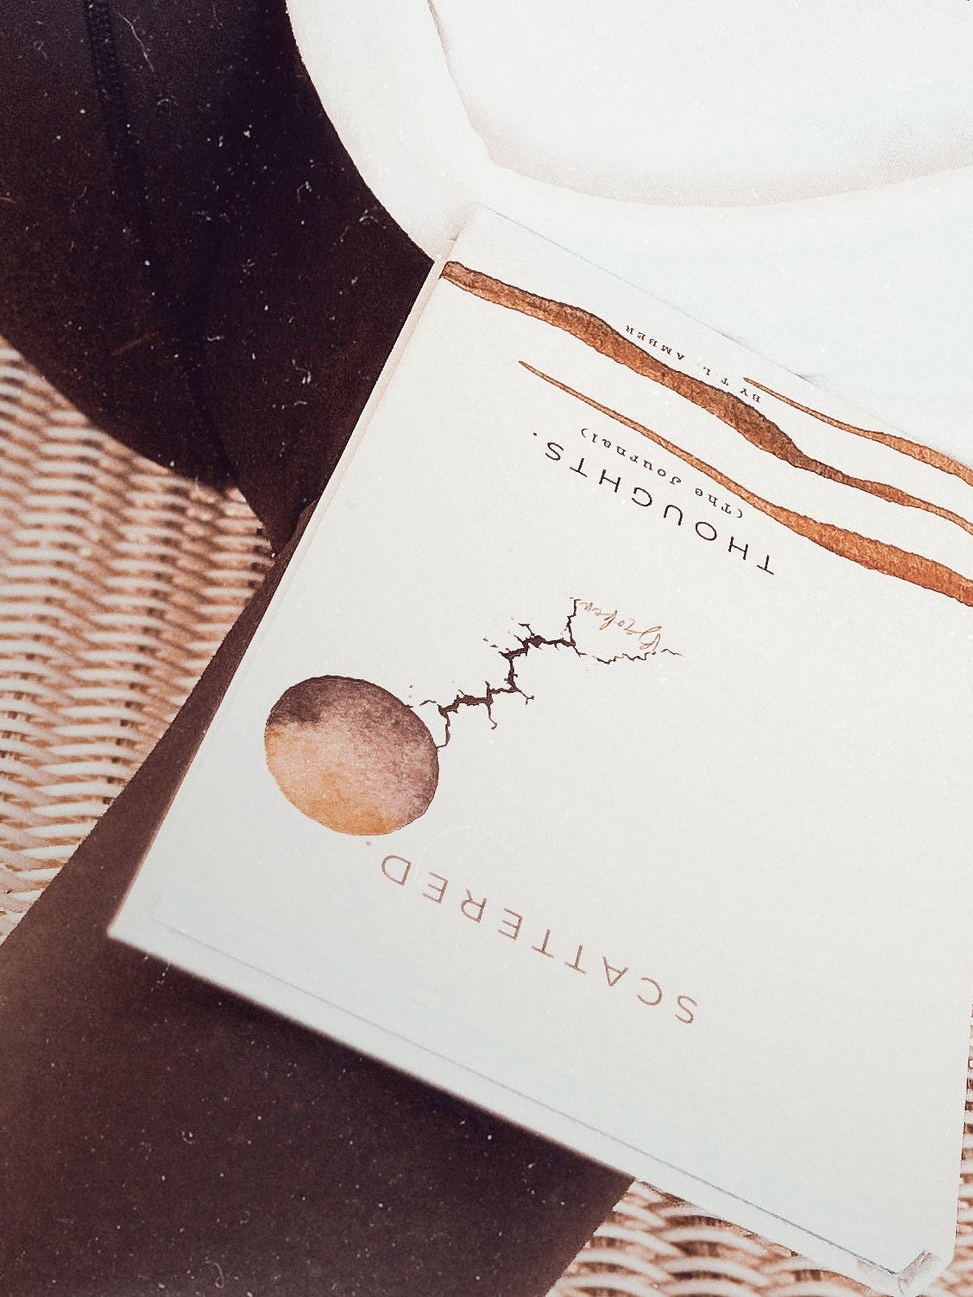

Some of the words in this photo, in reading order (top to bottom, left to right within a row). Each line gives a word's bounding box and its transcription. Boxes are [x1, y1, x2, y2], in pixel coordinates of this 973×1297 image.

[624, 324, 686, 362] AMBER
[739, 386, 762, 404] BY
[580, 427, 682, 486] Journal)
[532, 432, 776, 576] THOUGHTS.
[693, 487, 744, 520] (The
